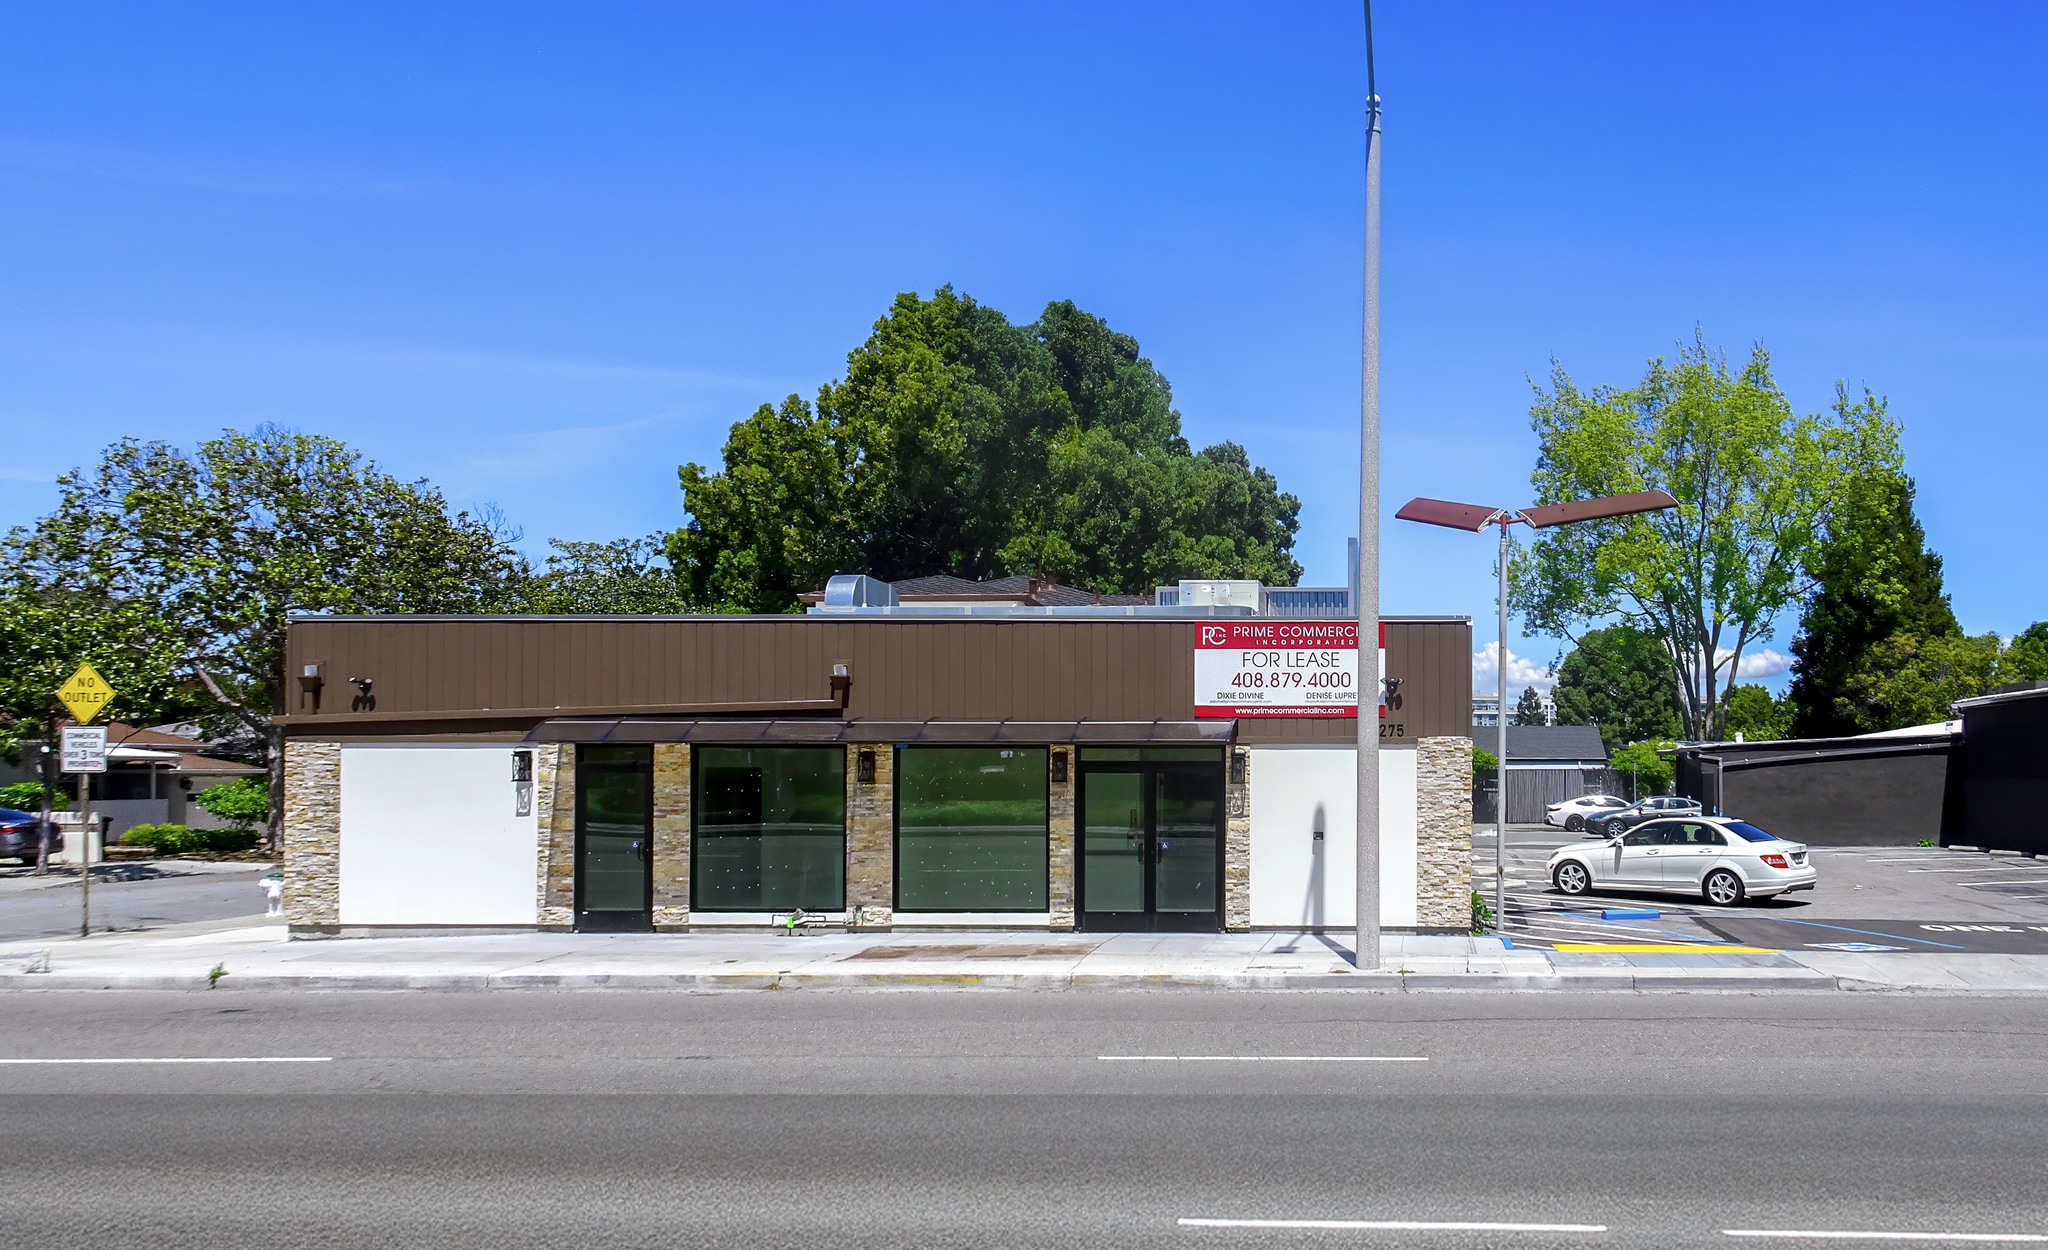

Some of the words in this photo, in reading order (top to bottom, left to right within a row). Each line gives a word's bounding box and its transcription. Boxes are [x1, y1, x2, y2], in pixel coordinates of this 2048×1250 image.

[1233, 626, 1274, 637] PRIME
[1279, 626, 1358, 638] COMMERCI
[1242, 652, 1280, 668] FOR
[1287, 652, 1340, 668] LEASE
[77, 678, 95, 688] NO
[1231, 672, 1351, 688] 408.879.4000
[64, 692, 107, 703] OUTLET
[1216, 692, 1236, 700] DIXIE
[1239, 692, 1264, 700] DIVINE
[1235, 707, 1345, 715] www.primecommercialinc.com
[1379, 724, 1404, 737] 275
[81, 749, 88, 760] 3
[1919, 924, 2025, 933] ONE
